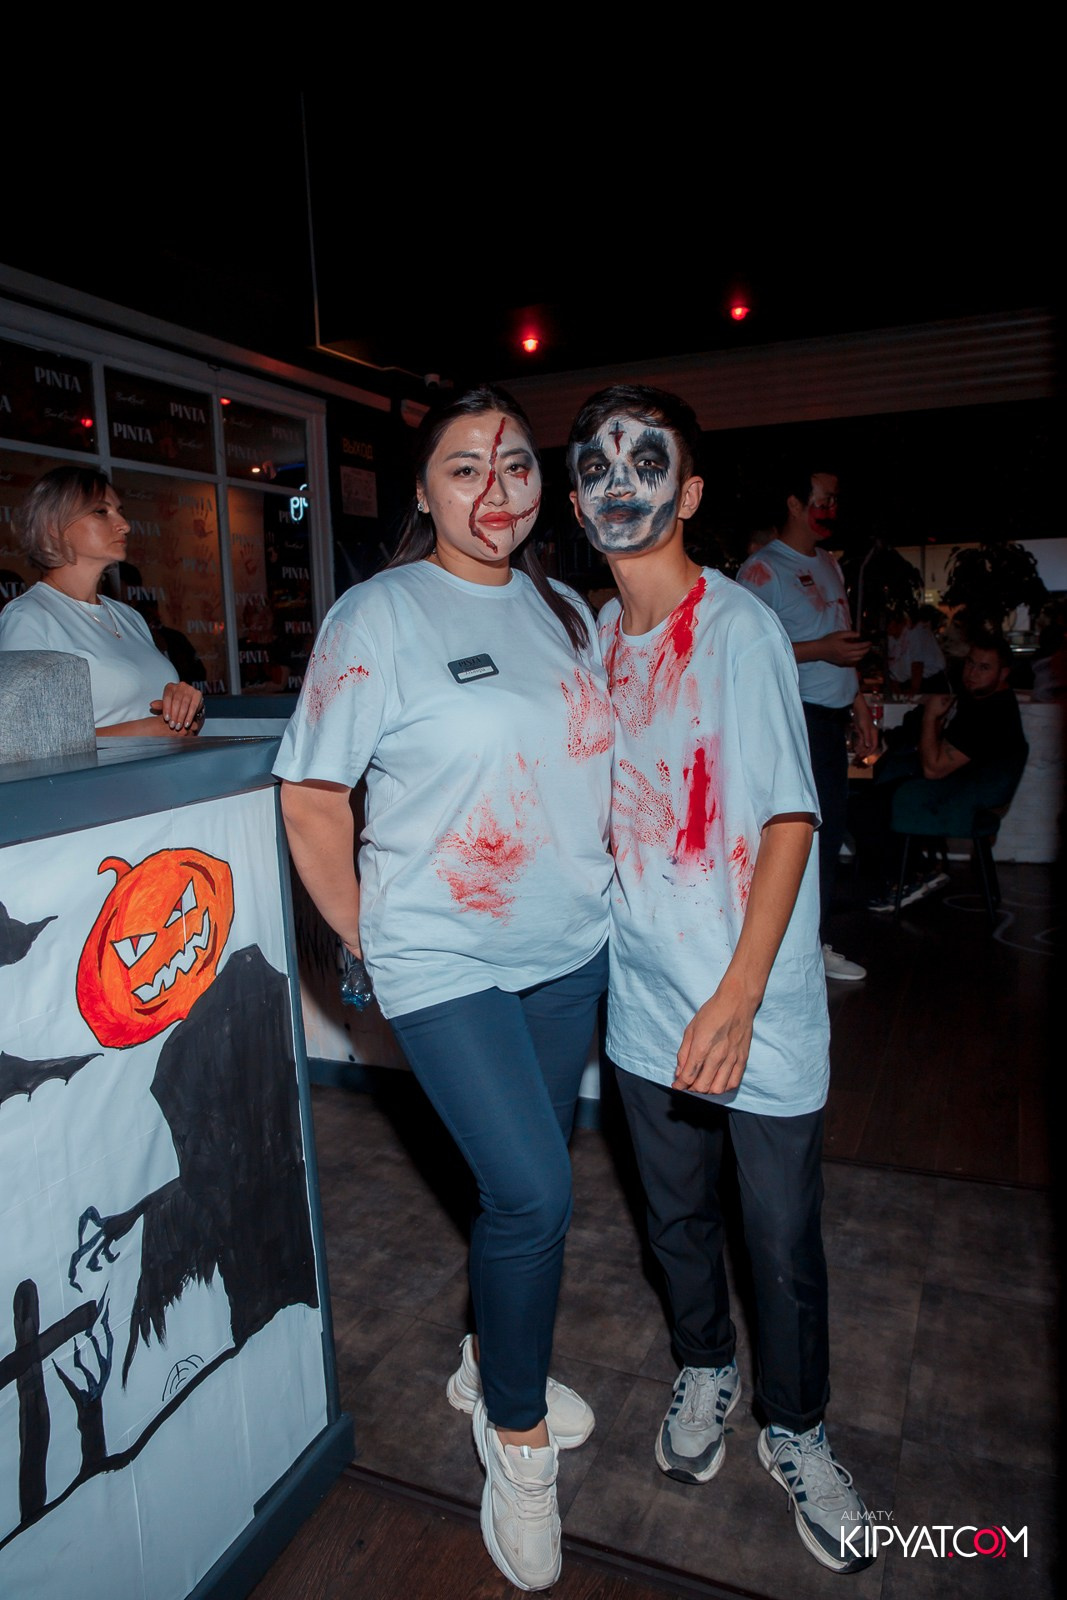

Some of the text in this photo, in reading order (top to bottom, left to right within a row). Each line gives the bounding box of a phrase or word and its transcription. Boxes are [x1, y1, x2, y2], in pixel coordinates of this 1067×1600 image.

[34, 366, 82, 393] PINTA
[170, 402, 207, 424] PINTA
[112, 421, 154, 444] PINTA
[129, 519, 160, 537] INTA
[282, 566, 310, 580] PINTA
[127, 584, 165, 602] PINTA
[285, 620, 313, 634] PINTA
[239, 649, 270, 664] PINTA
[288, 675, 305, 689] PIN
